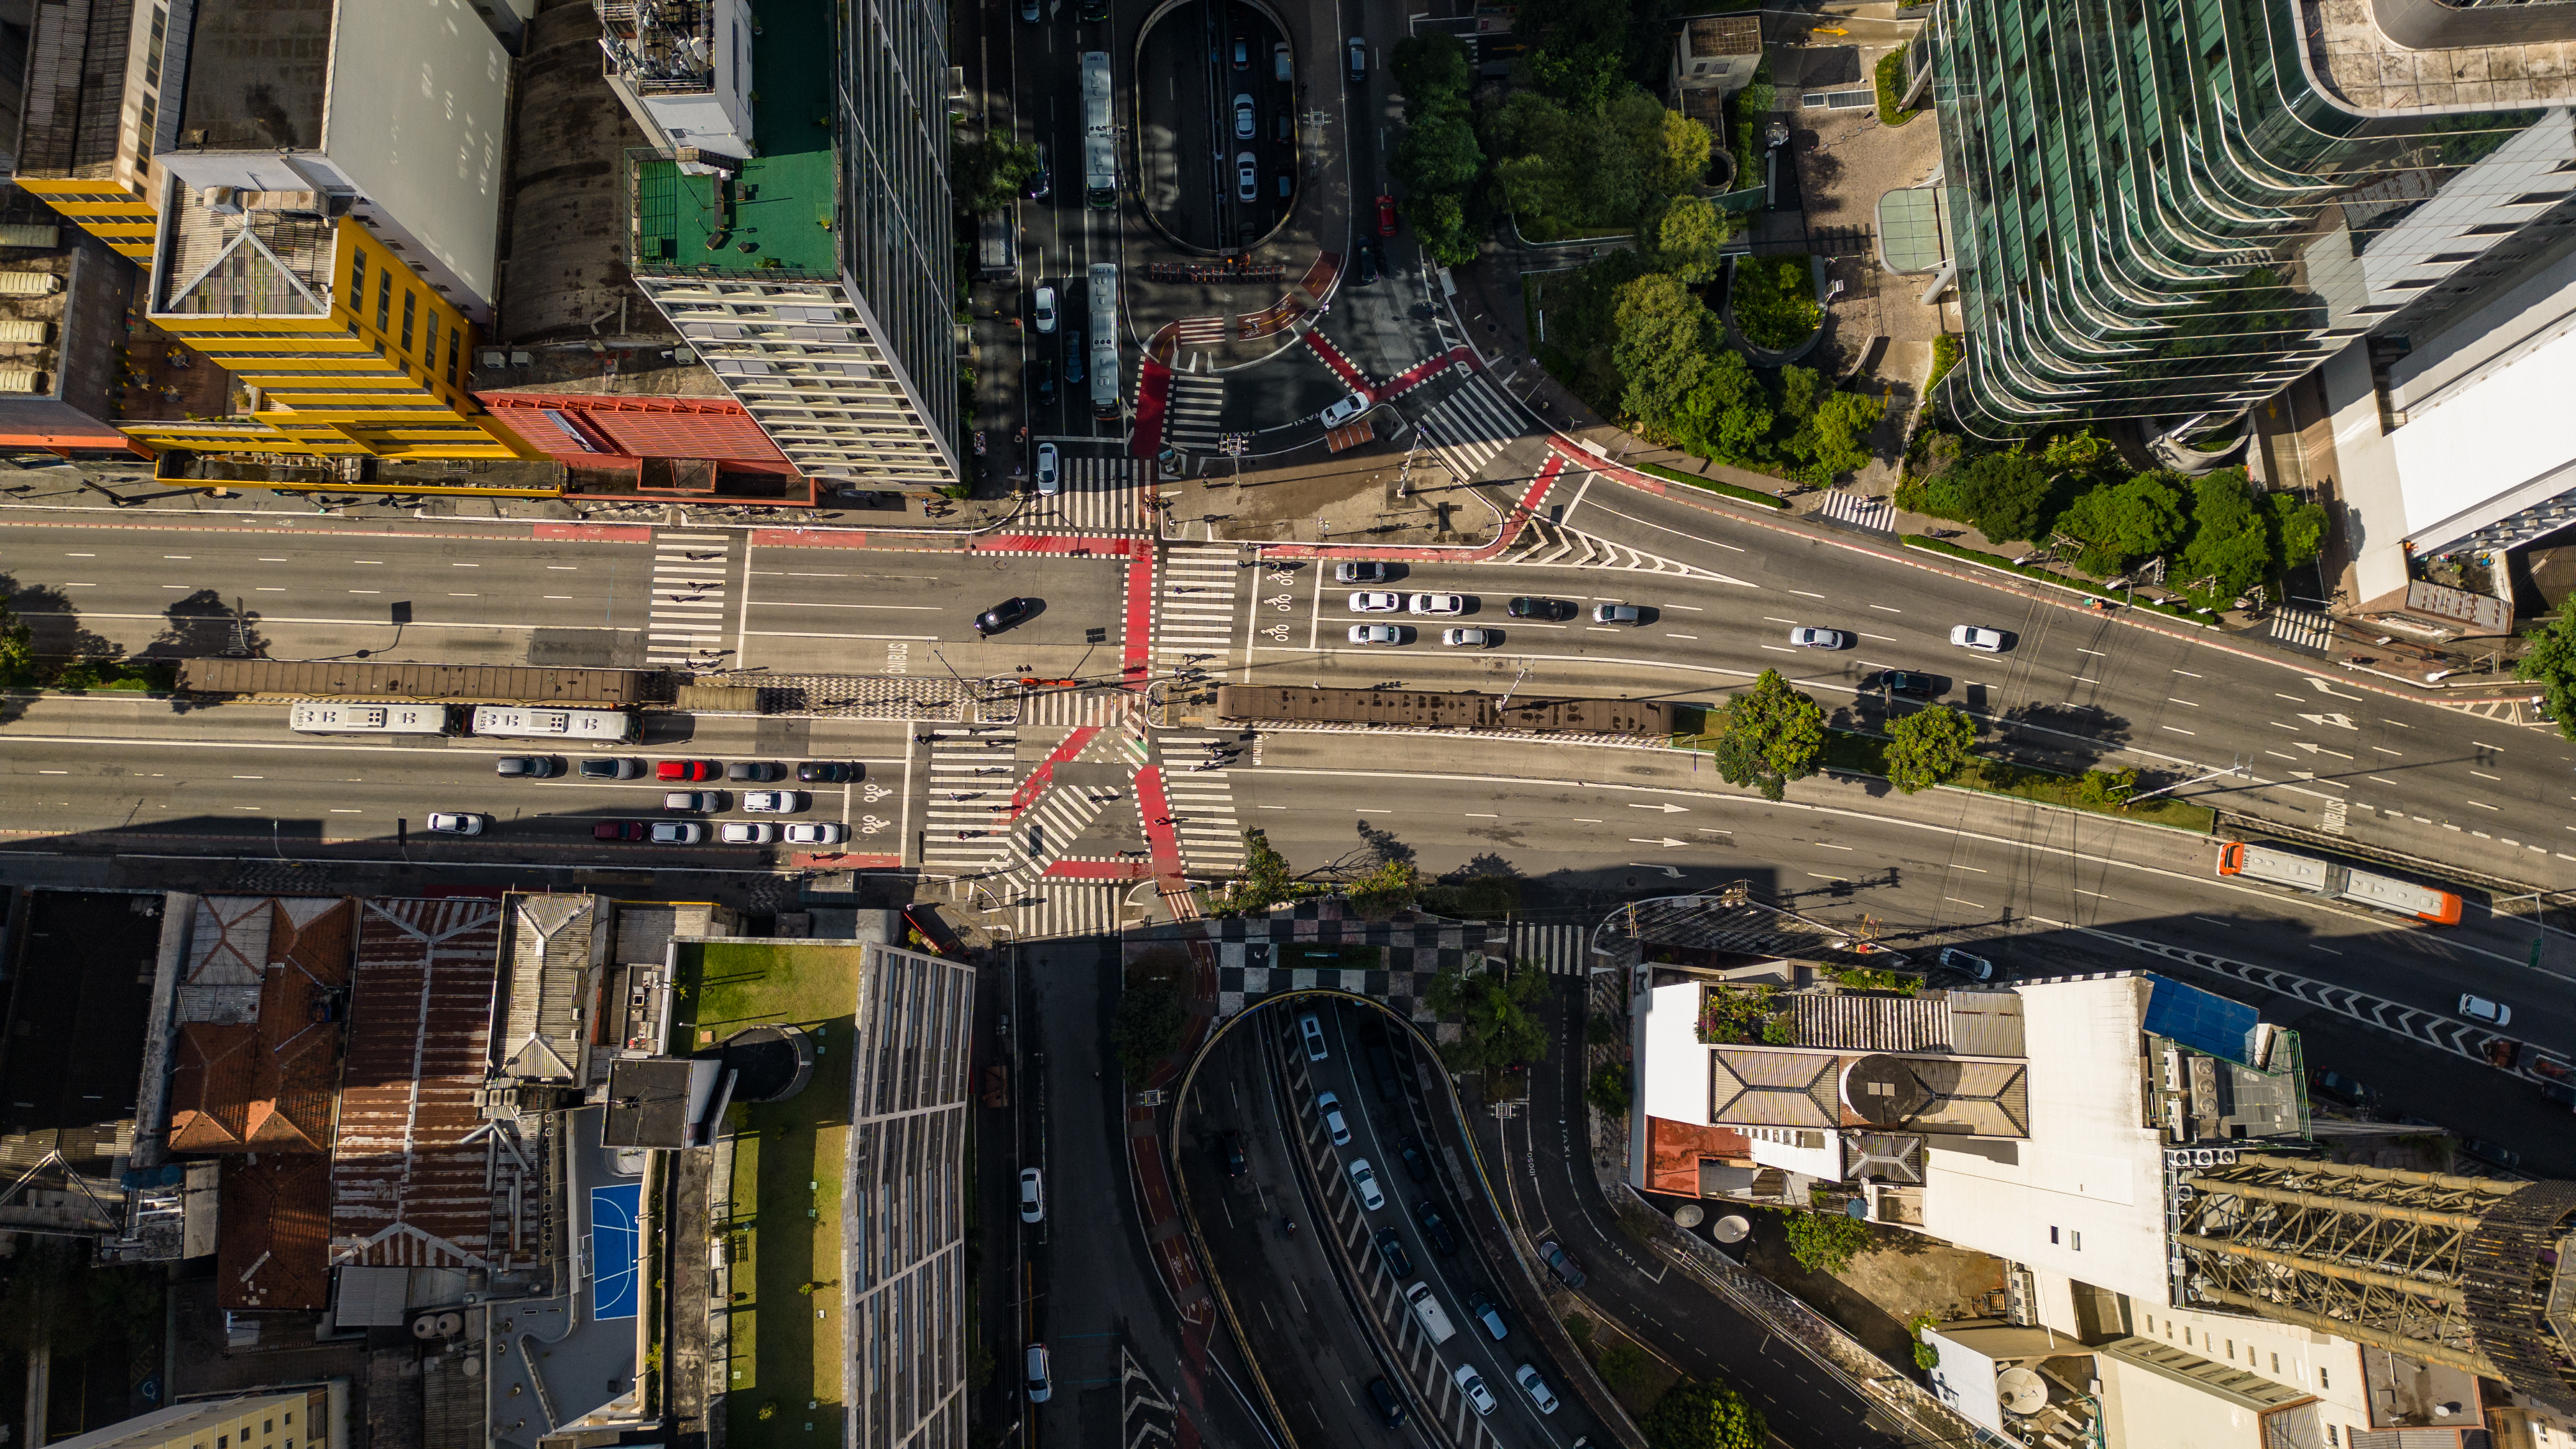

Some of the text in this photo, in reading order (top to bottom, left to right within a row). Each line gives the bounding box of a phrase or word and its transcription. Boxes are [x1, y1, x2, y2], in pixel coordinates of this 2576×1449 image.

[1294, 413, 1321, 427] TAXI
[879, 643, 908, 674] ÔNIBUS
[2314, 800, 2347, 836] ÔNIBUS
[1562, 1127, 1571, 1158] TAXI
[1527, 1153, 1536, 1176] IDOSO
[1611, 1241, 1636, 1266] TAXI
